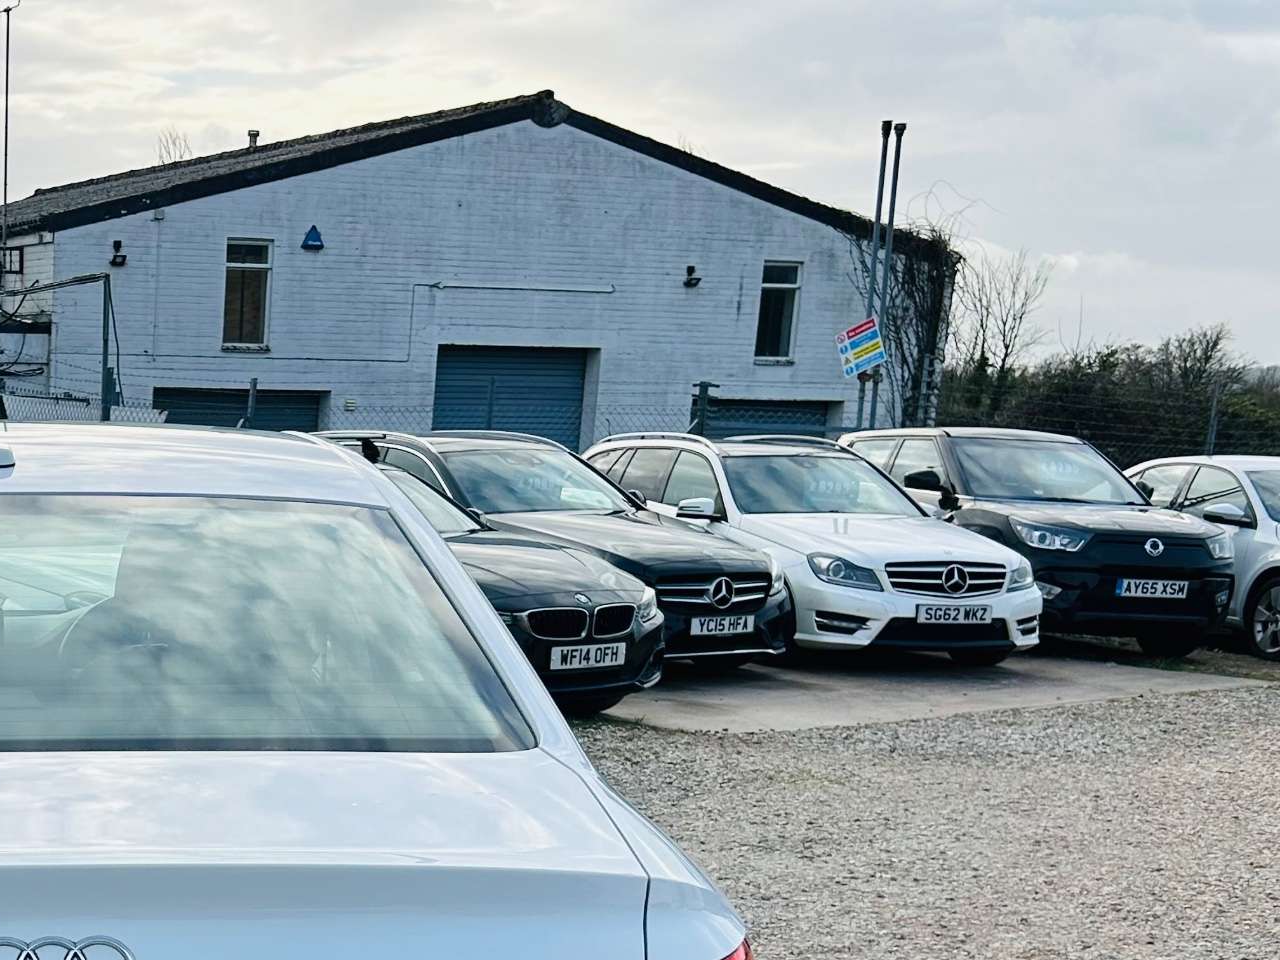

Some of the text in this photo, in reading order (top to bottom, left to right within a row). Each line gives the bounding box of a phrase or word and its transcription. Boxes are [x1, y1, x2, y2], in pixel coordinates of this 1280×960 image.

[1124, 581, 1186, 596] AY65 XSM
[924, 607, 988, 622] SG62 WKZ
[698, 616, 748, 632] YC15 HFA
[560, 645, 619, 666] WF14 OFH
